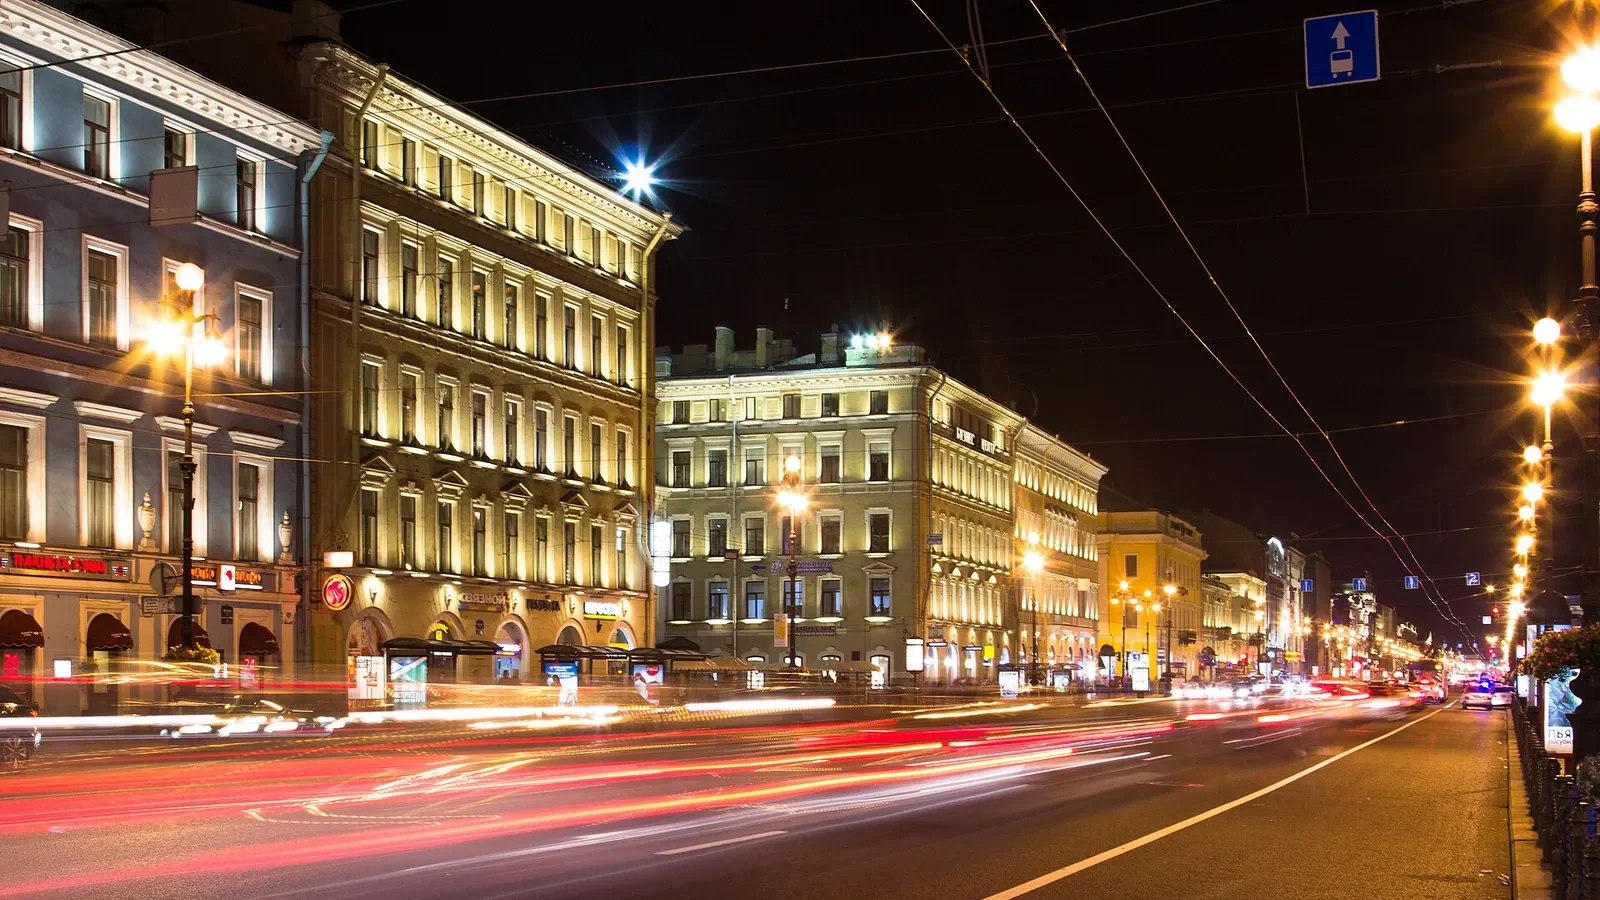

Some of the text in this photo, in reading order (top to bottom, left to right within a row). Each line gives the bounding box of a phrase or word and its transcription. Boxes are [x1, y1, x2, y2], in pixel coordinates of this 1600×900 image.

[459, 592, 506, 605] СВЯЗНОЙ
[244, 658, 256, 670] 24
[1548, 729, 1572, 739] ПЬЯ
